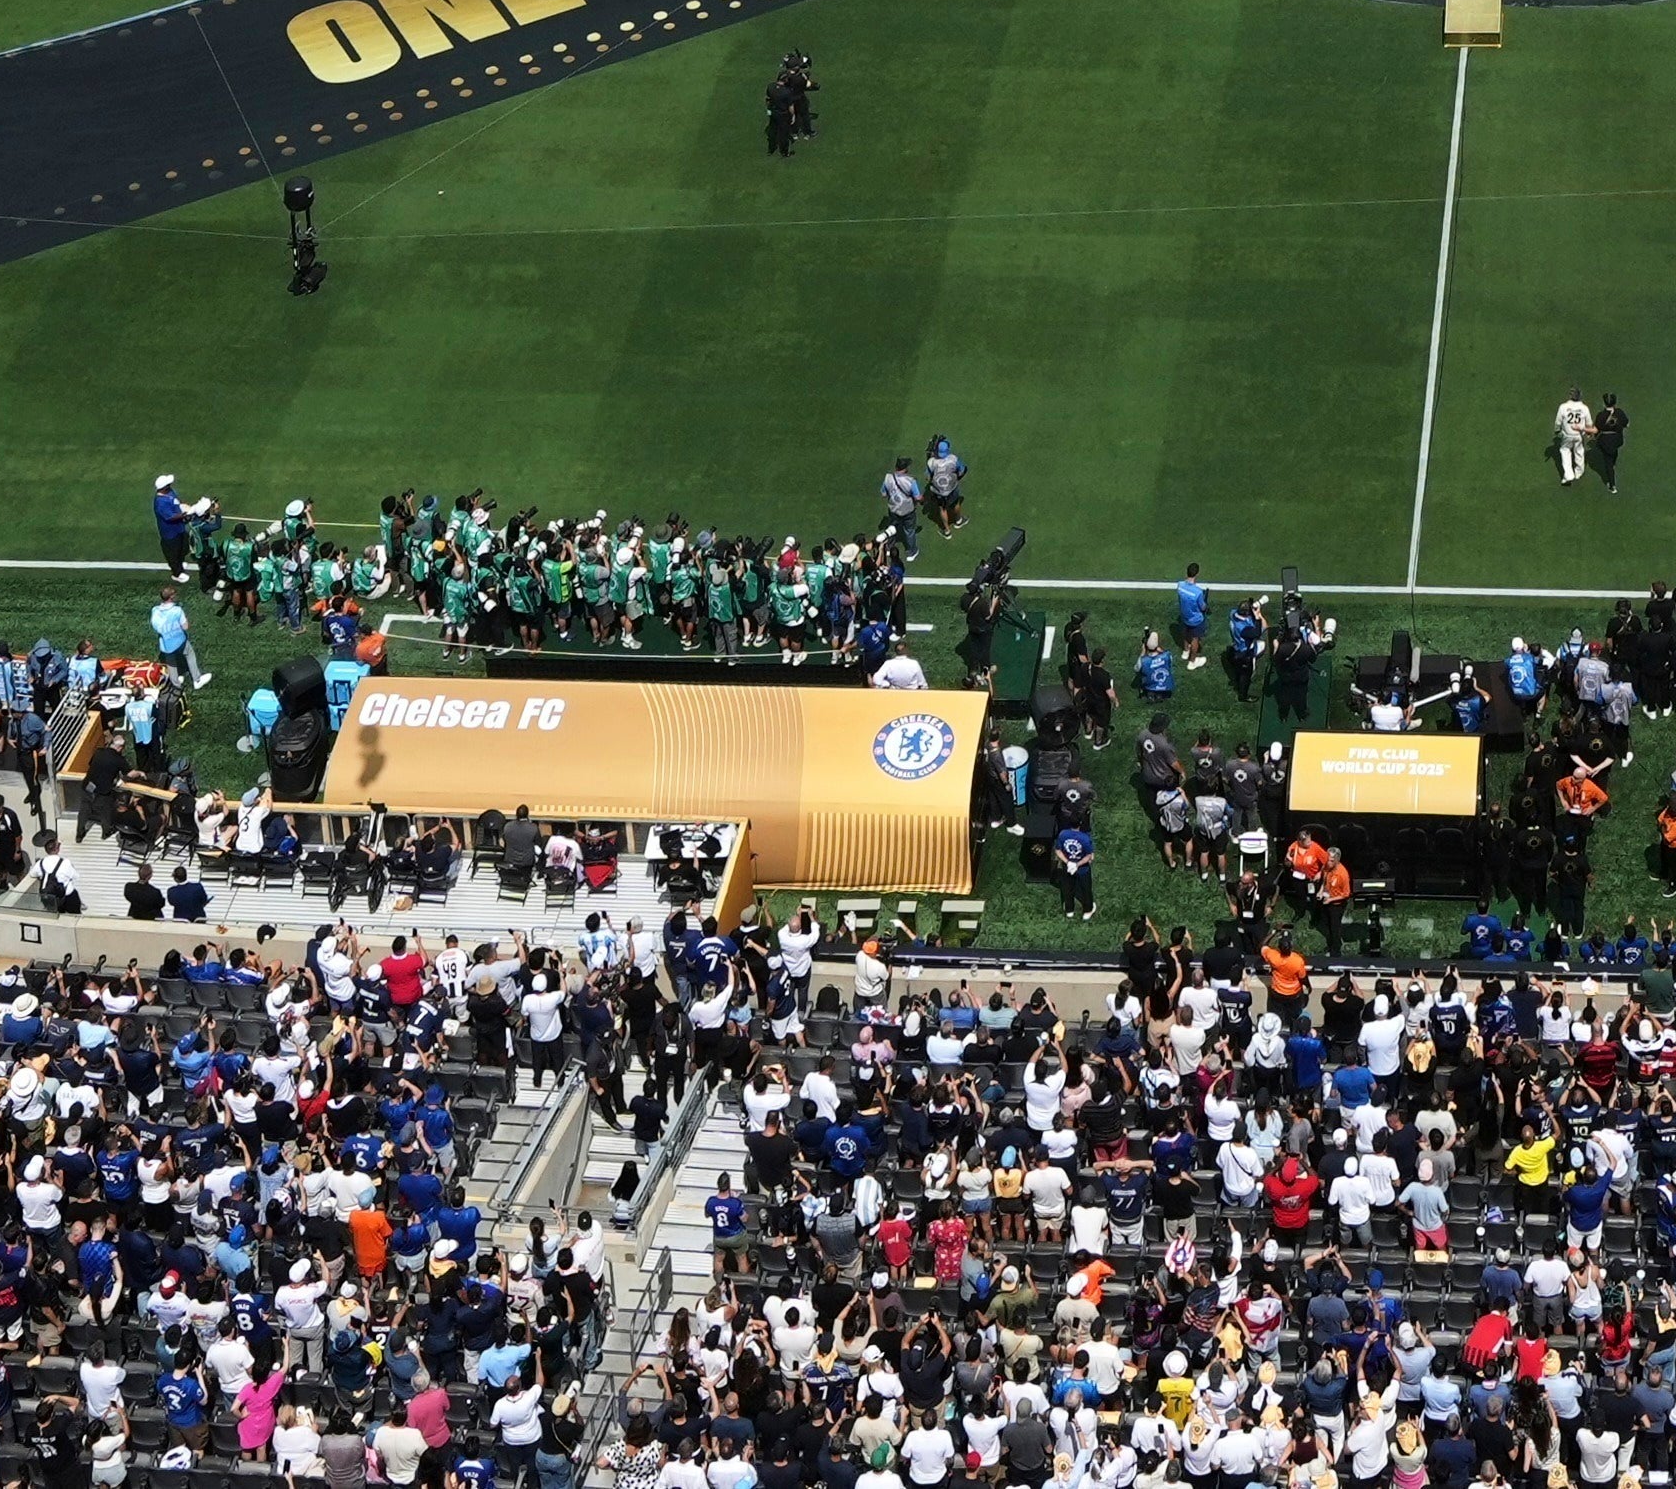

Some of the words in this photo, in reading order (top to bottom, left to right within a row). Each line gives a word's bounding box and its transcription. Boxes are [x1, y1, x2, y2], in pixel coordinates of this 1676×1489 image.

[359, 693, 511, 729] Chelsea
[517, 698, 565, 730] FC
[890, 715, 946, 732] CHELSEA
[1348, 748, 1380, 759] FIFA
[1383, 749, 1419, 760] CLUB
[1322, 761, 1374, 774] WORLD
[1377, 762, 1406, 775] CUP
[442, 962, 457, 980] 49
[705, 953, 719, 973] 7
[1443, 1019, 1455, 1034] 10
[1573, 1125, 1589, 1136] 10
[355, 1151, 368, 1169] 6
[237, 1313, 254, 1331] 8
[168, 1393, 182, 1411] 3
[1170, 1397, 1182, 1413] 7
